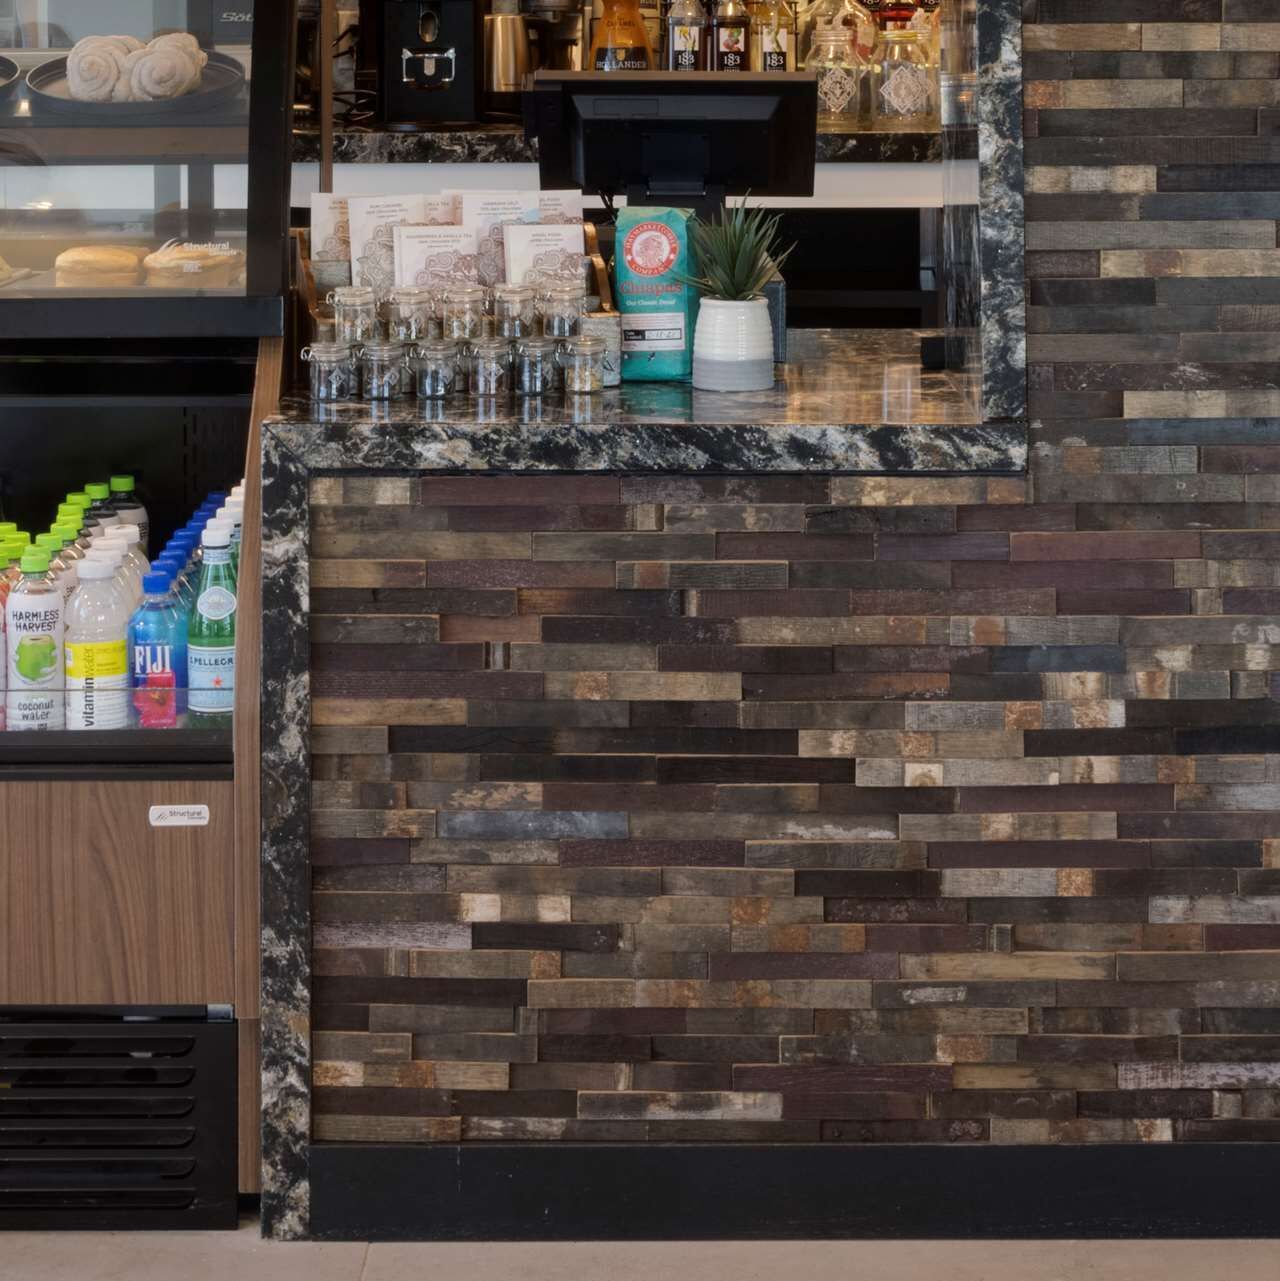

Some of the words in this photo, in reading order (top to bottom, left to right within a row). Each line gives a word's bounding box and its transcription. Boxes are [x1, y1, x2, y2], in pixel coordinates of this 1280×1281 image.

[596, 61, 648, 70] HOLLANDER
[678, 52, 695, 66] 1883
[724, 52, 741, 66] 1883
[620, 281, 682, 296] Chiapas
[12, 609, 60, 622] HARMLESS
[15, 620, 57, 632] HARVEST
[134, 645, 171, 674] FIJI
[17, 699, 55, 711] coconut
[22, 709, 50, 720] water
